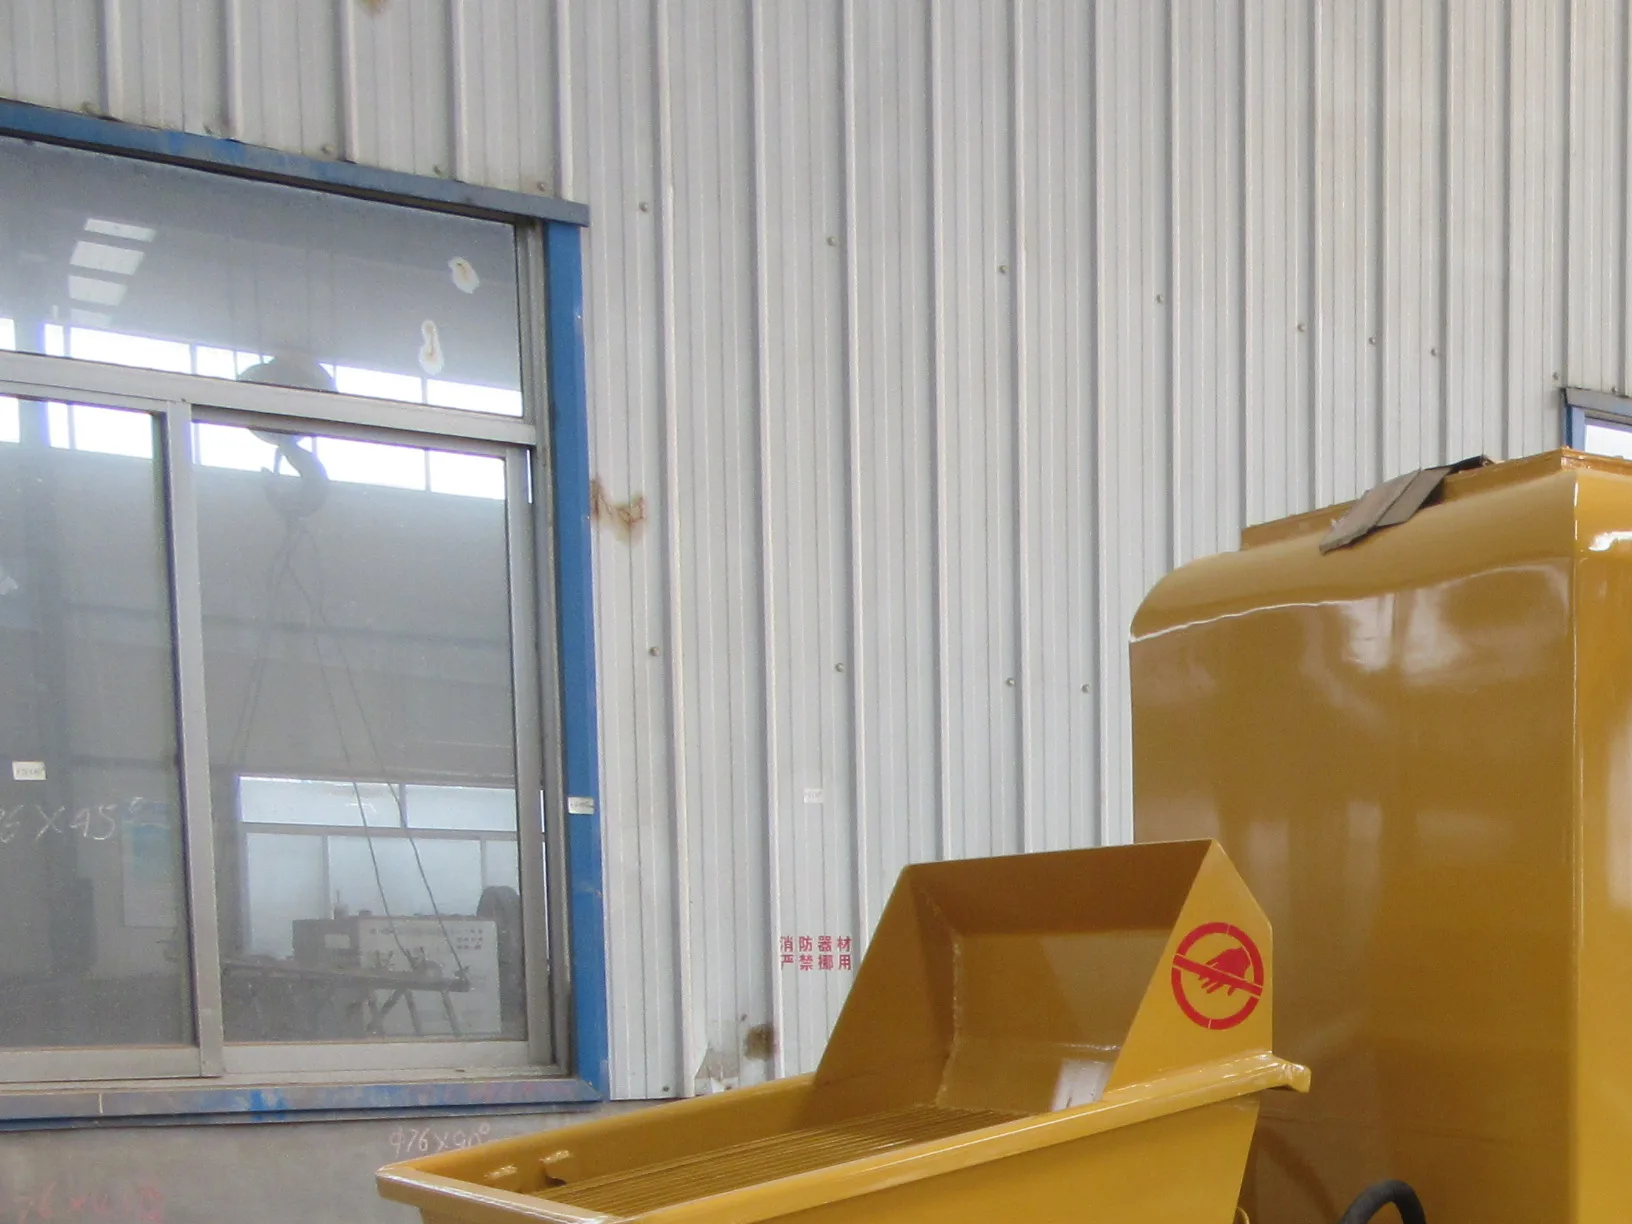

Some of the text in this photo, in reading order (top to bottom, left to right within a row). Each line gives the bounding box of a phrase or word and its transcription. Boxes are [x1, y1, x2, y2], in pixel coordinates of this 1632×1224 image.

[780, 935, 852, 952] 消防器材
[781, 954, 852, 971] 严禁挪用
